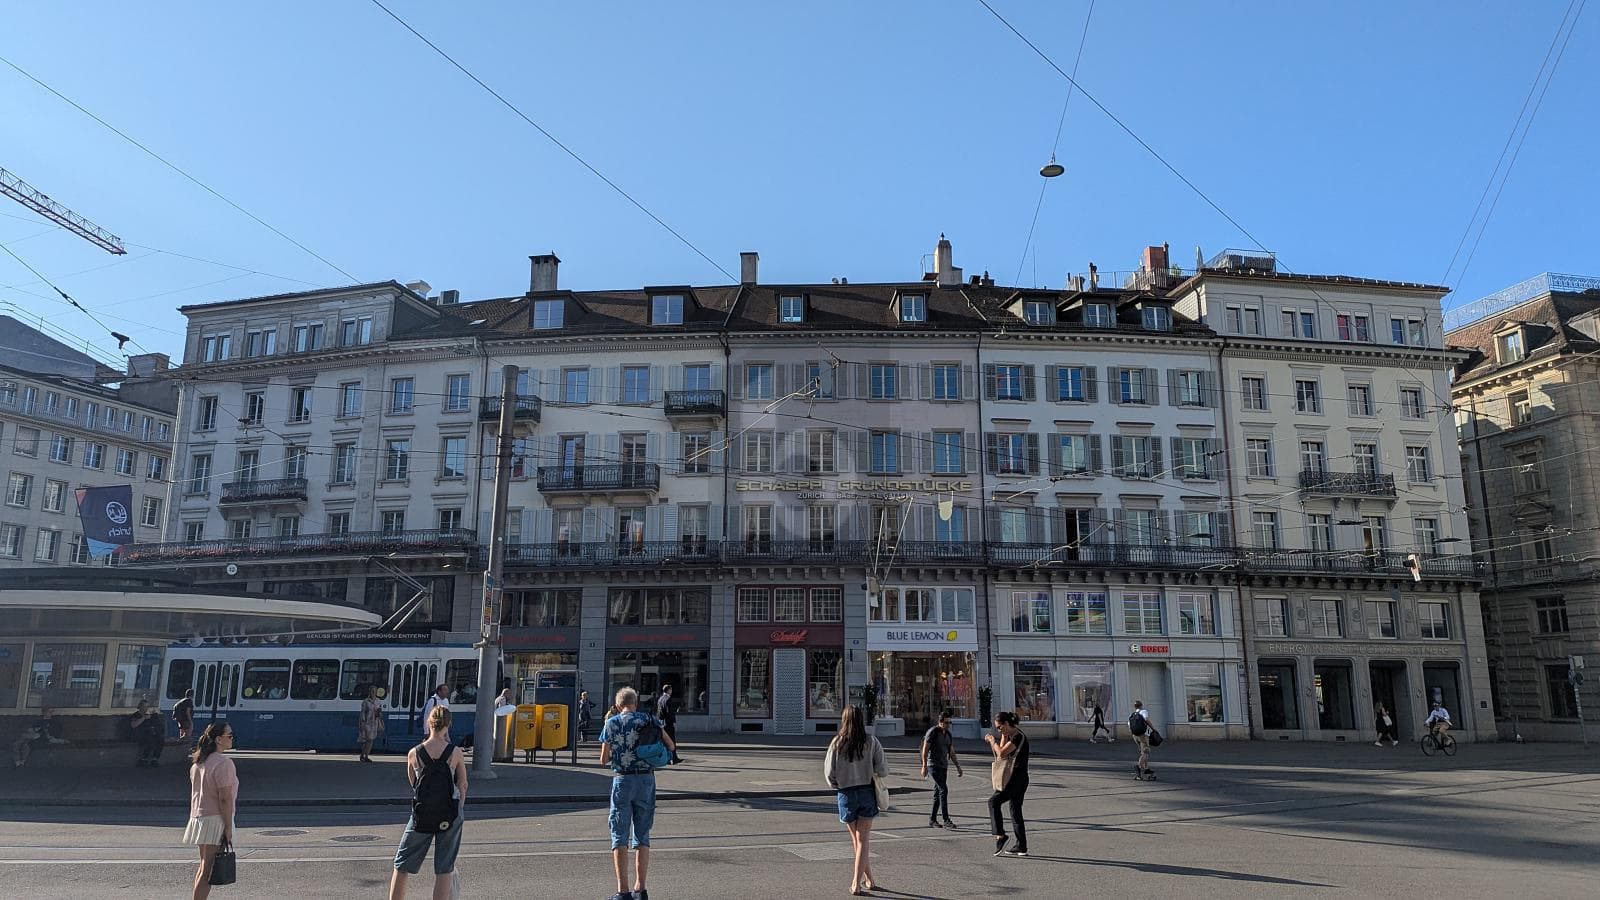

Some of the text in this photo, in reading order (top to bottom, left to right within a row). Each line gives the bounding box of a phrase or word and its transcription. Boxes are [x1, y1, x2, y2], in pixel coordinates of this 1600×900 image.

[736, 478, 972, 491] SCHAEPPI GRUNDSTÜCKE
[886, 631, 944, 641] BLUE LEMON
[1269, 643, 1308, 653] ENERGY
